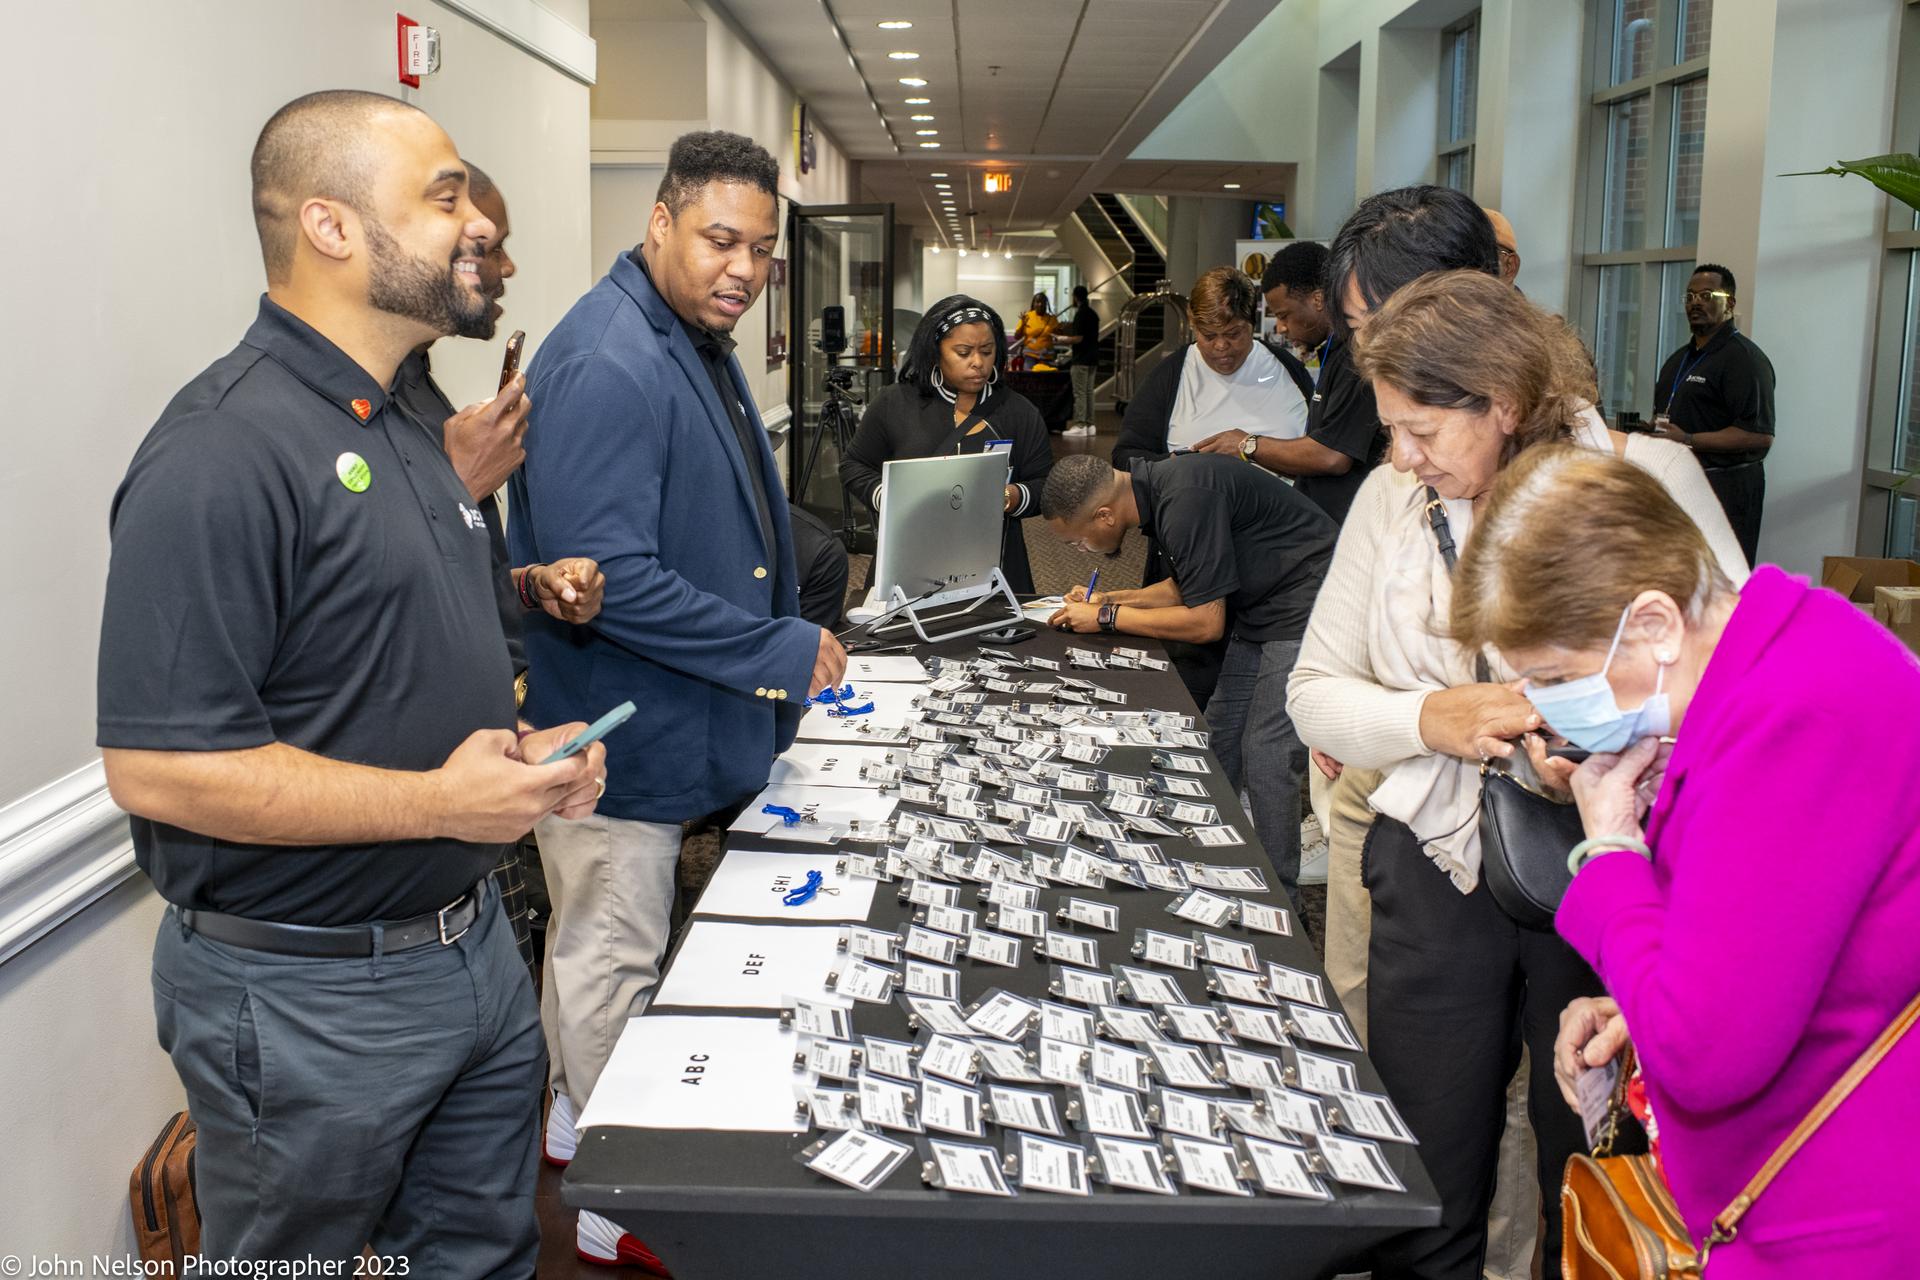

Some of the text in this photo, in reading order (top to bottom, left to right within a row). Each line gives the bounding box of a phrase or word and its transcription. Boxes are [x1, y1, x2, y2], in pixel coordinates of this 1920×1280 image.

[412, 33, 421, 67] FIRE
[771, 875, 792, 892] GHI
[742, 953, 766, 975] DEF
[680, 1053, 710, 1086] ABC
